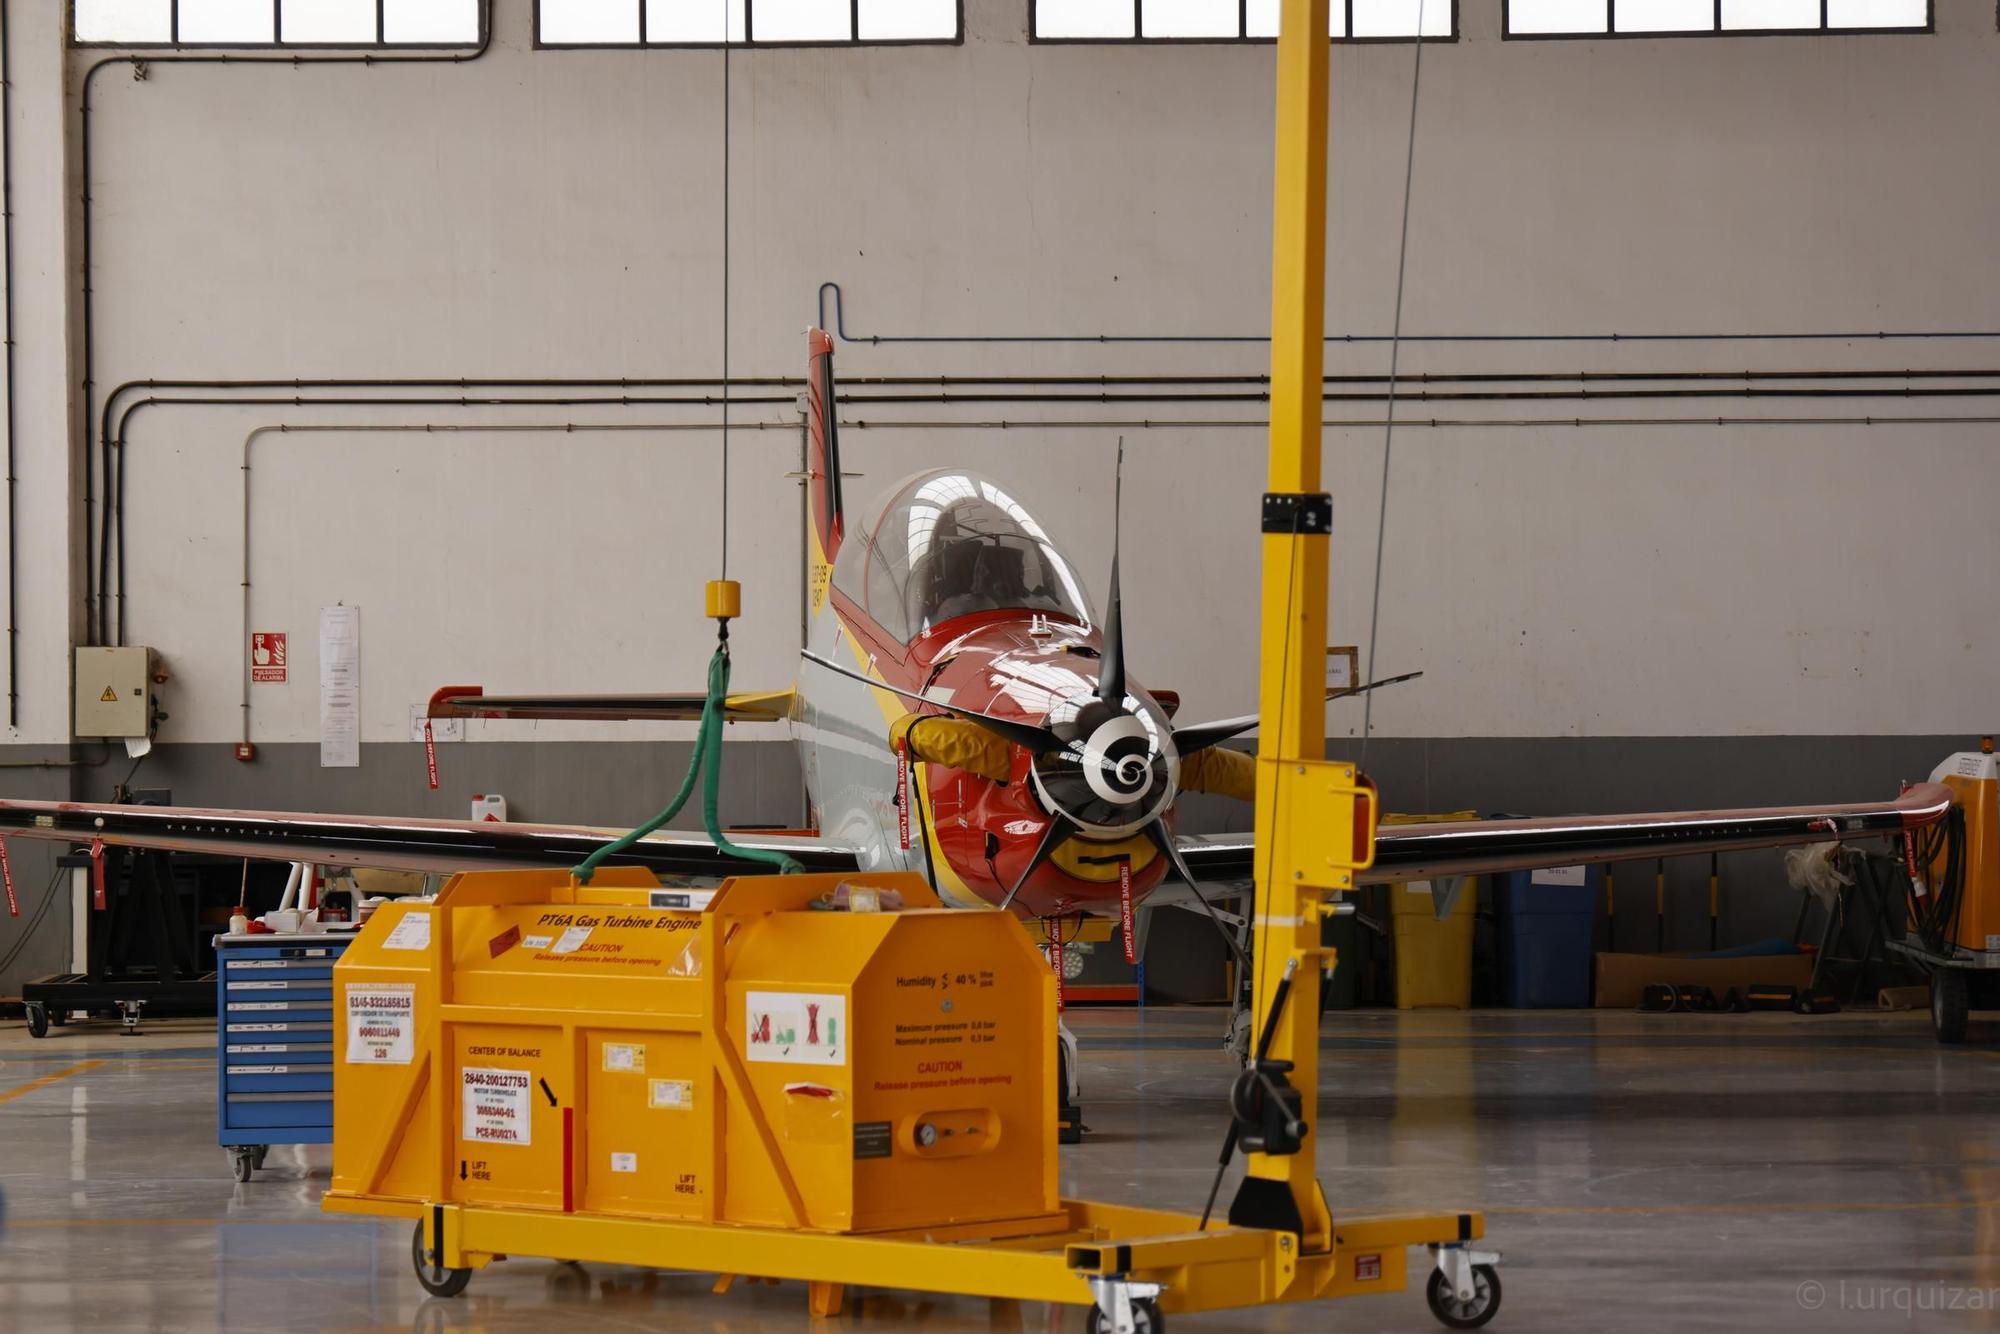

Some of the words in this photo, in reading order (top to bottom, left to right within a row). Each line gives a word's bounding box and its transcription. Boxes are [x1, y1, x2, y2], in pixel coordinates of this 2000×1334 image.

[429, 766, 437, 785] FLIGHT
[1121, 866, 1130, 899] REMOVE
[1122, 901, 1131, 930] BEFORE
[537, 914, 574, 927] PT6A
[575, 914, 601, 927] Gas
[603, 915, 653, 928] Turbine
[654, 916, 702, 932] Engine
[581, 943, 623, 952] CAUTION
[1125, 932, 1133, 958] FLIGHT
[533, 953, 564, 961] Release
[628, 959, 661, 967] opening
[896, 976, 936, 988] Humidity
[956, 974, 966, 984] 40
[896, 1024, 932, 1032] Maximum
[934, 1023, 968, 1032] pressure
[983, 1021, 996, 1029] bar
[896, 1038, 927, 1046] Nominal
[929, 1036, 962, 1045] pressure
[468, 1046, 495, 1055] CENTER
[497, 1048, 506, 1056] OF
[508, 1048, 541, 1057] BALANCE
[918, 1061, 962, 1073] CAUTION
[465, 1073, 528, 1088] 2840-200127753
[874, 1081, 908, 1090] Release
[910, 1080, 948, 1090] pressure
[949, 1077, 976, 1086] before
[978, 1075, 1012, 1085] opening
[472, 1160, 486, 1170] LIFT
[472, 1171, 491, 1181] HERE
[680, 1174, 696, 1184] LIFT
[674, 1183, 696, 1194] HERE
